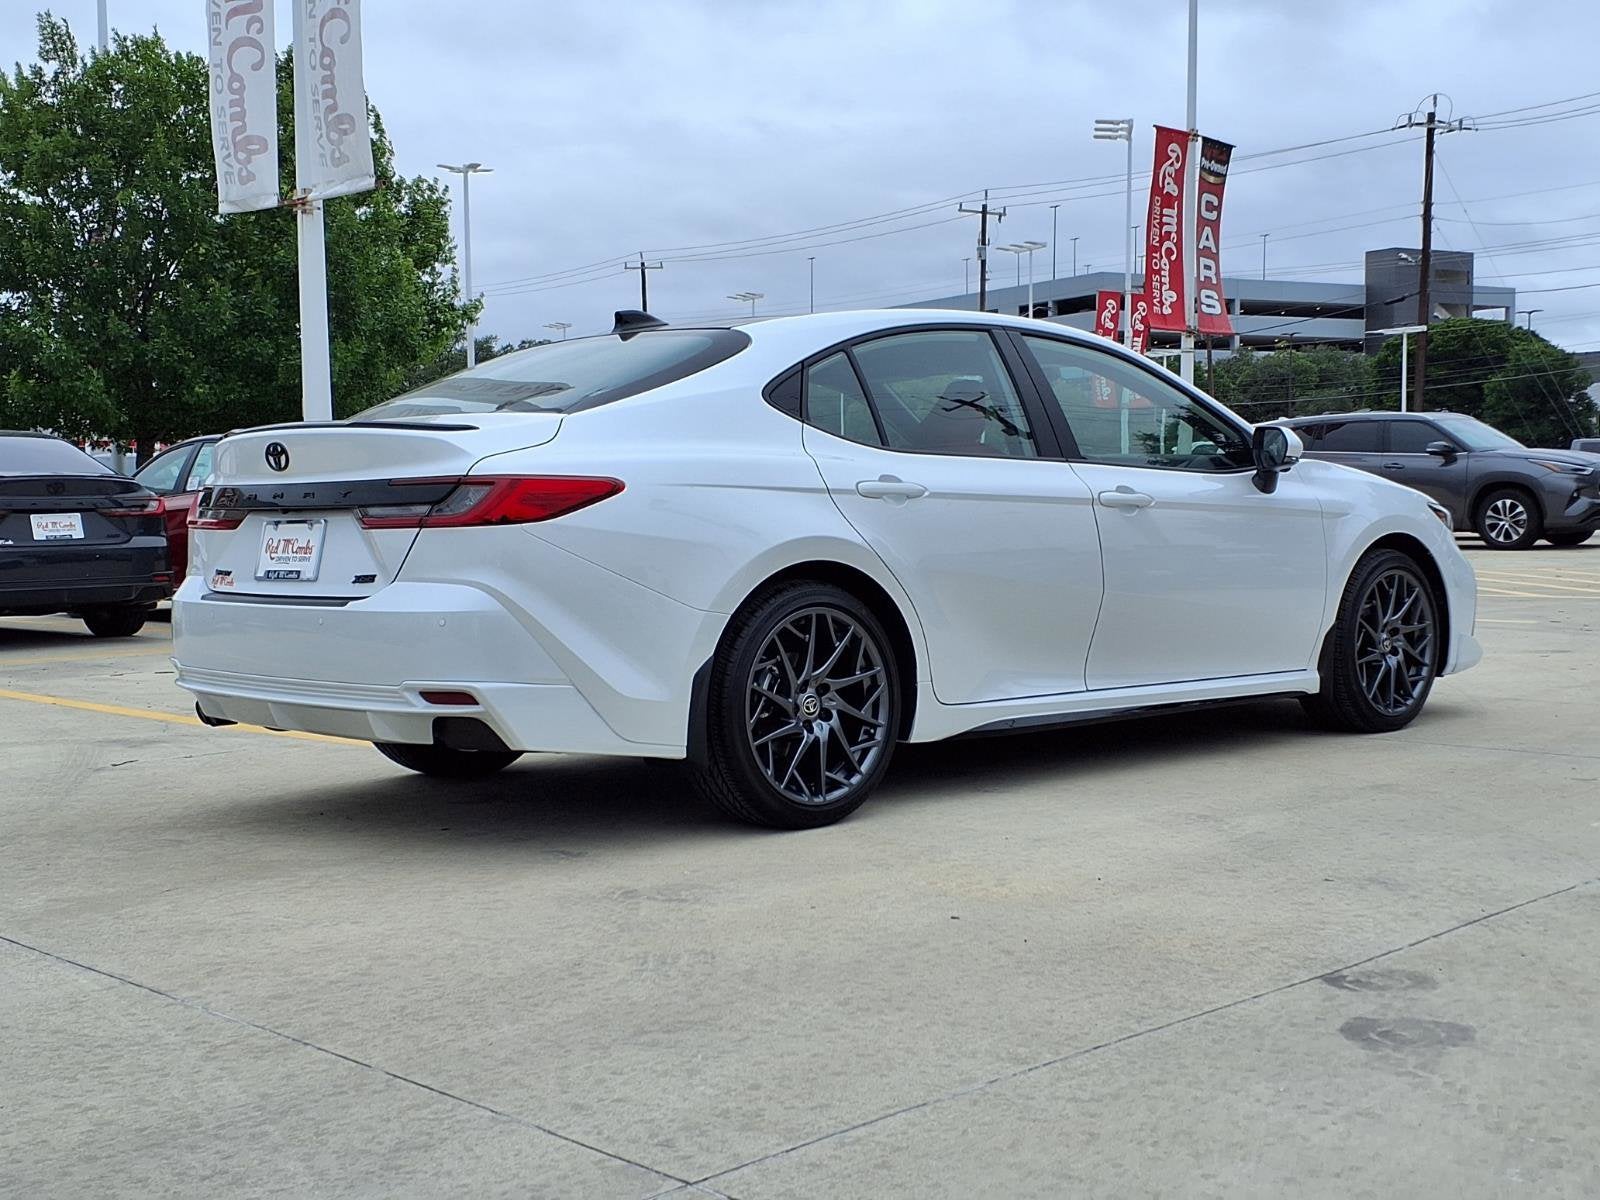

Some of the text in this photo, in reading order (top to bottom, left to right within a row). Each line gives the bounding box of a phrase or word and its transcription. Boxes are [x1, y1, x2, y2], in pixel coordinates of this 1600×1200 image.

[213, 57, 224, 95] TO
[308, 33, 317, 72] TO
[319, 0, 357, 169] Combs
[217, 106, 235, 185] SERVE
[310, 82, 328, 169] SERVE
[1152, 196, 1161, 315] DRIVEN TO SERVE
[1159, 142, 1183, 316] Red McCombs
[1198, 192, 1222, 316] CARS
[1101, 299, 1117, 329] Red
[1132, 301, 1148, 331] Red
[265, 537, 315, 561] Red McCombs
